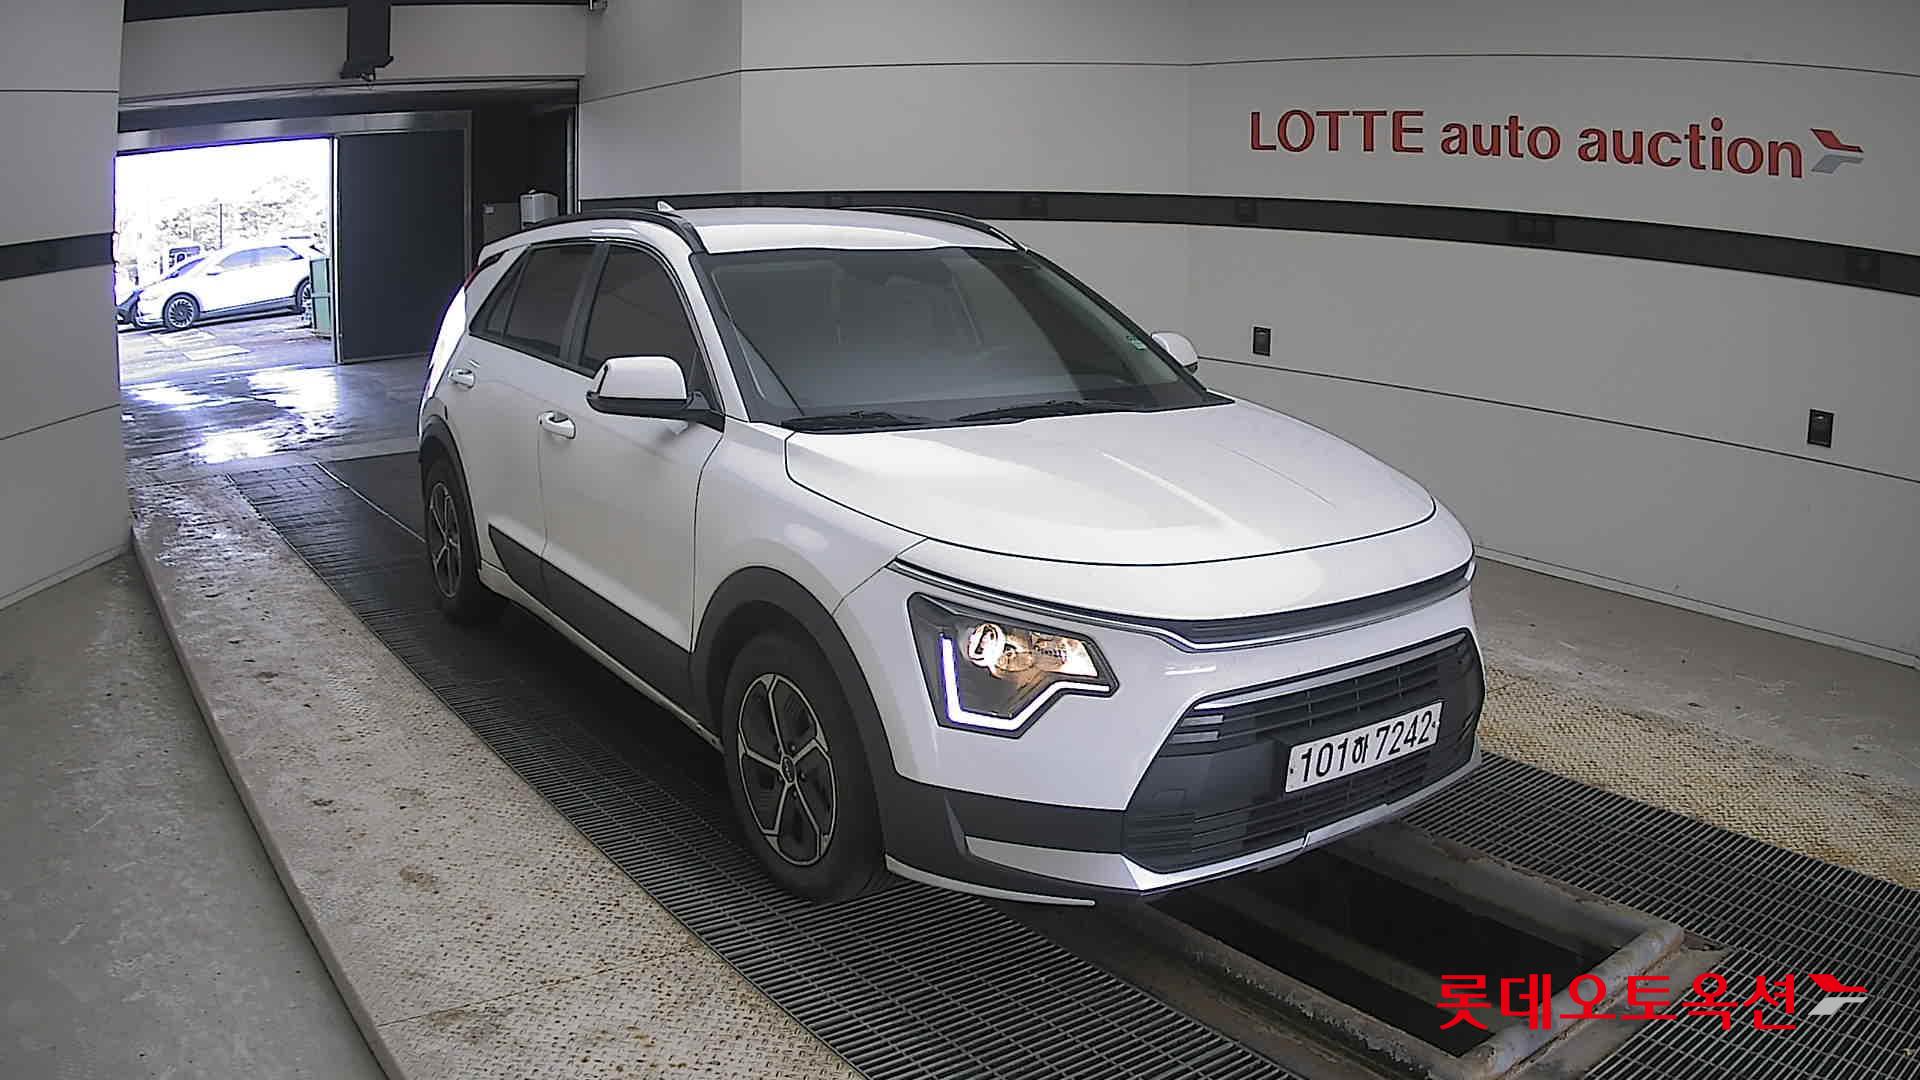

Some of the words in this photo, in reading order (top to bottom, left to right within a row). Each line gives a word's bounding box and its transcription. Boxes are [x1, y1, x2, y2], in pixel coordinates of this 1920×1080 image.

[1250, 110, 1425, 154] LOTTE
[1440, 115, 1561, 160] auto
[1577, 116, 1804, 179] auction
[1301, 732, 1369, 782] 101하
[1376, 710, 1433, 760] 7242
